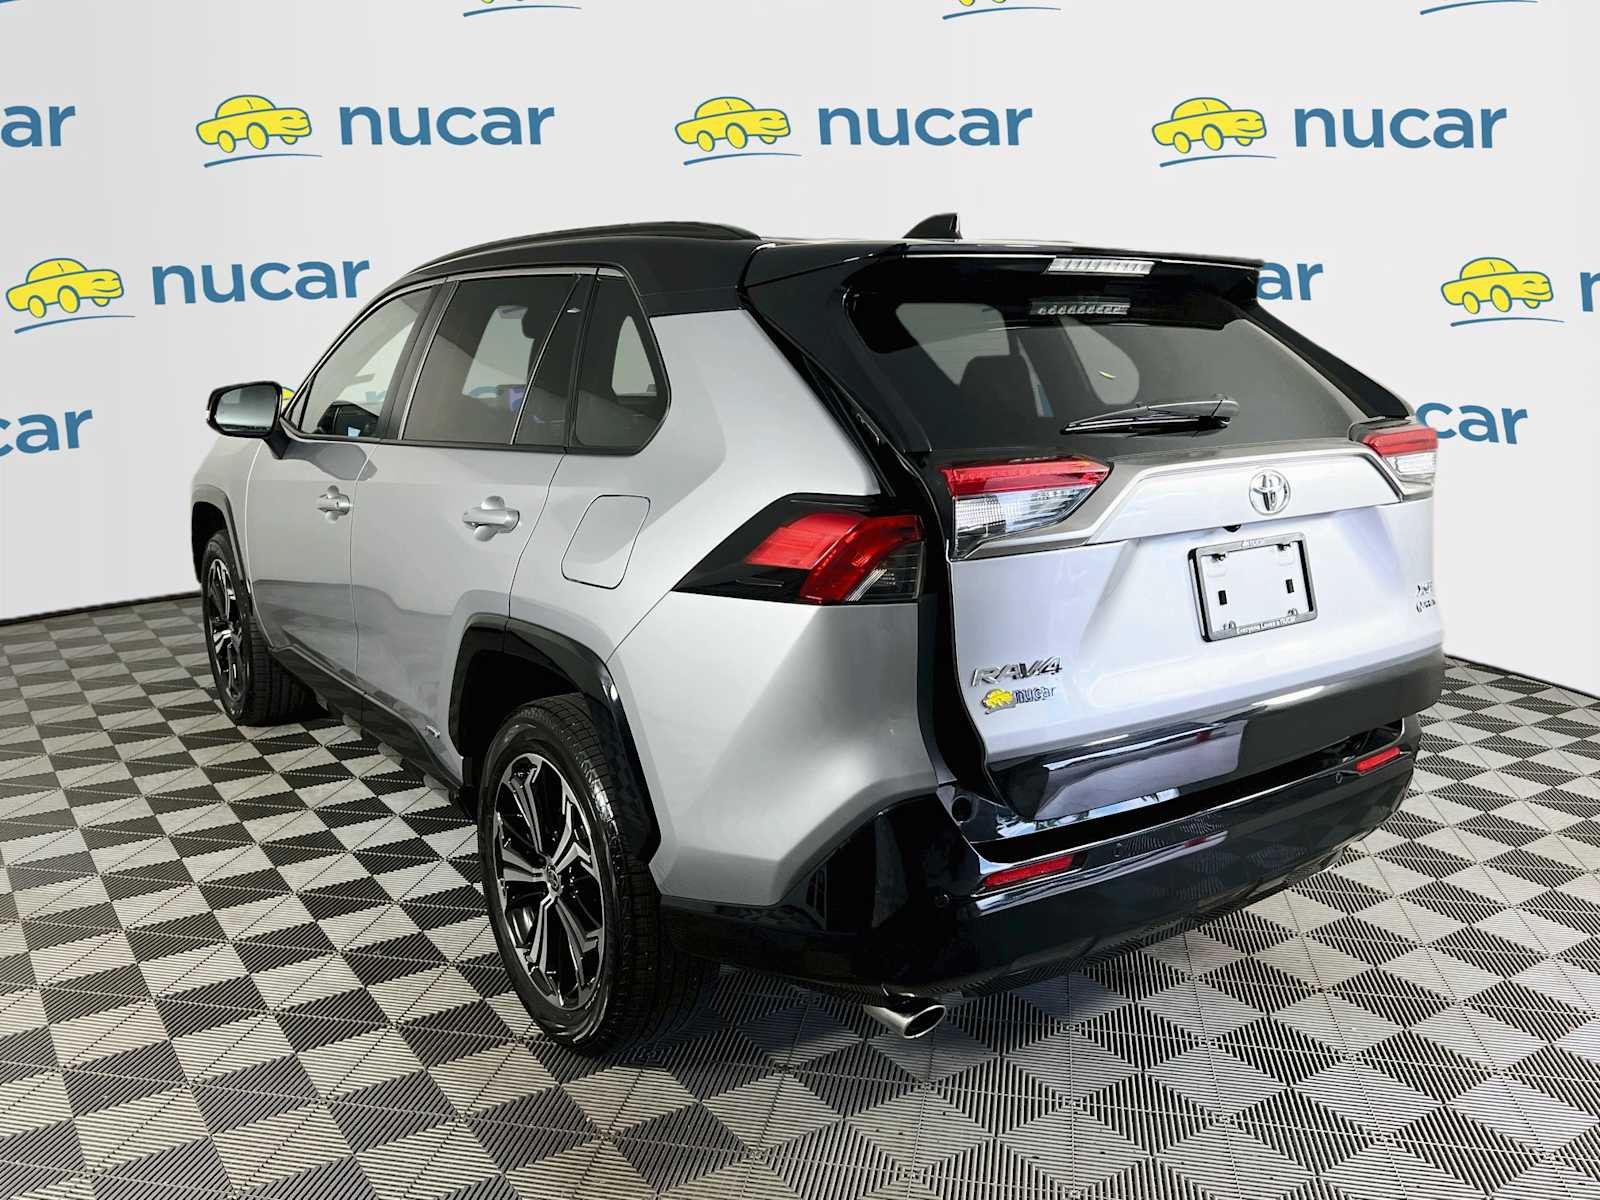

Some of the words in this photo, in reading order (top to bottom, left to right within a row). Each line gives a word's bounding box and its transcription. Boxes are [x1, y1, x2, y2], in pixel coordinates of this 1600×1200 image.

[340, 106, 555, 146] nucar
[818, 107, 1033, 146] nucar
[1295, 108, 1507, 149] nucar
[152, 260, 370, 305] nucar
[970, 656, 1063, 688] RAV4
[1014, 686, 1057, 704] nucar
